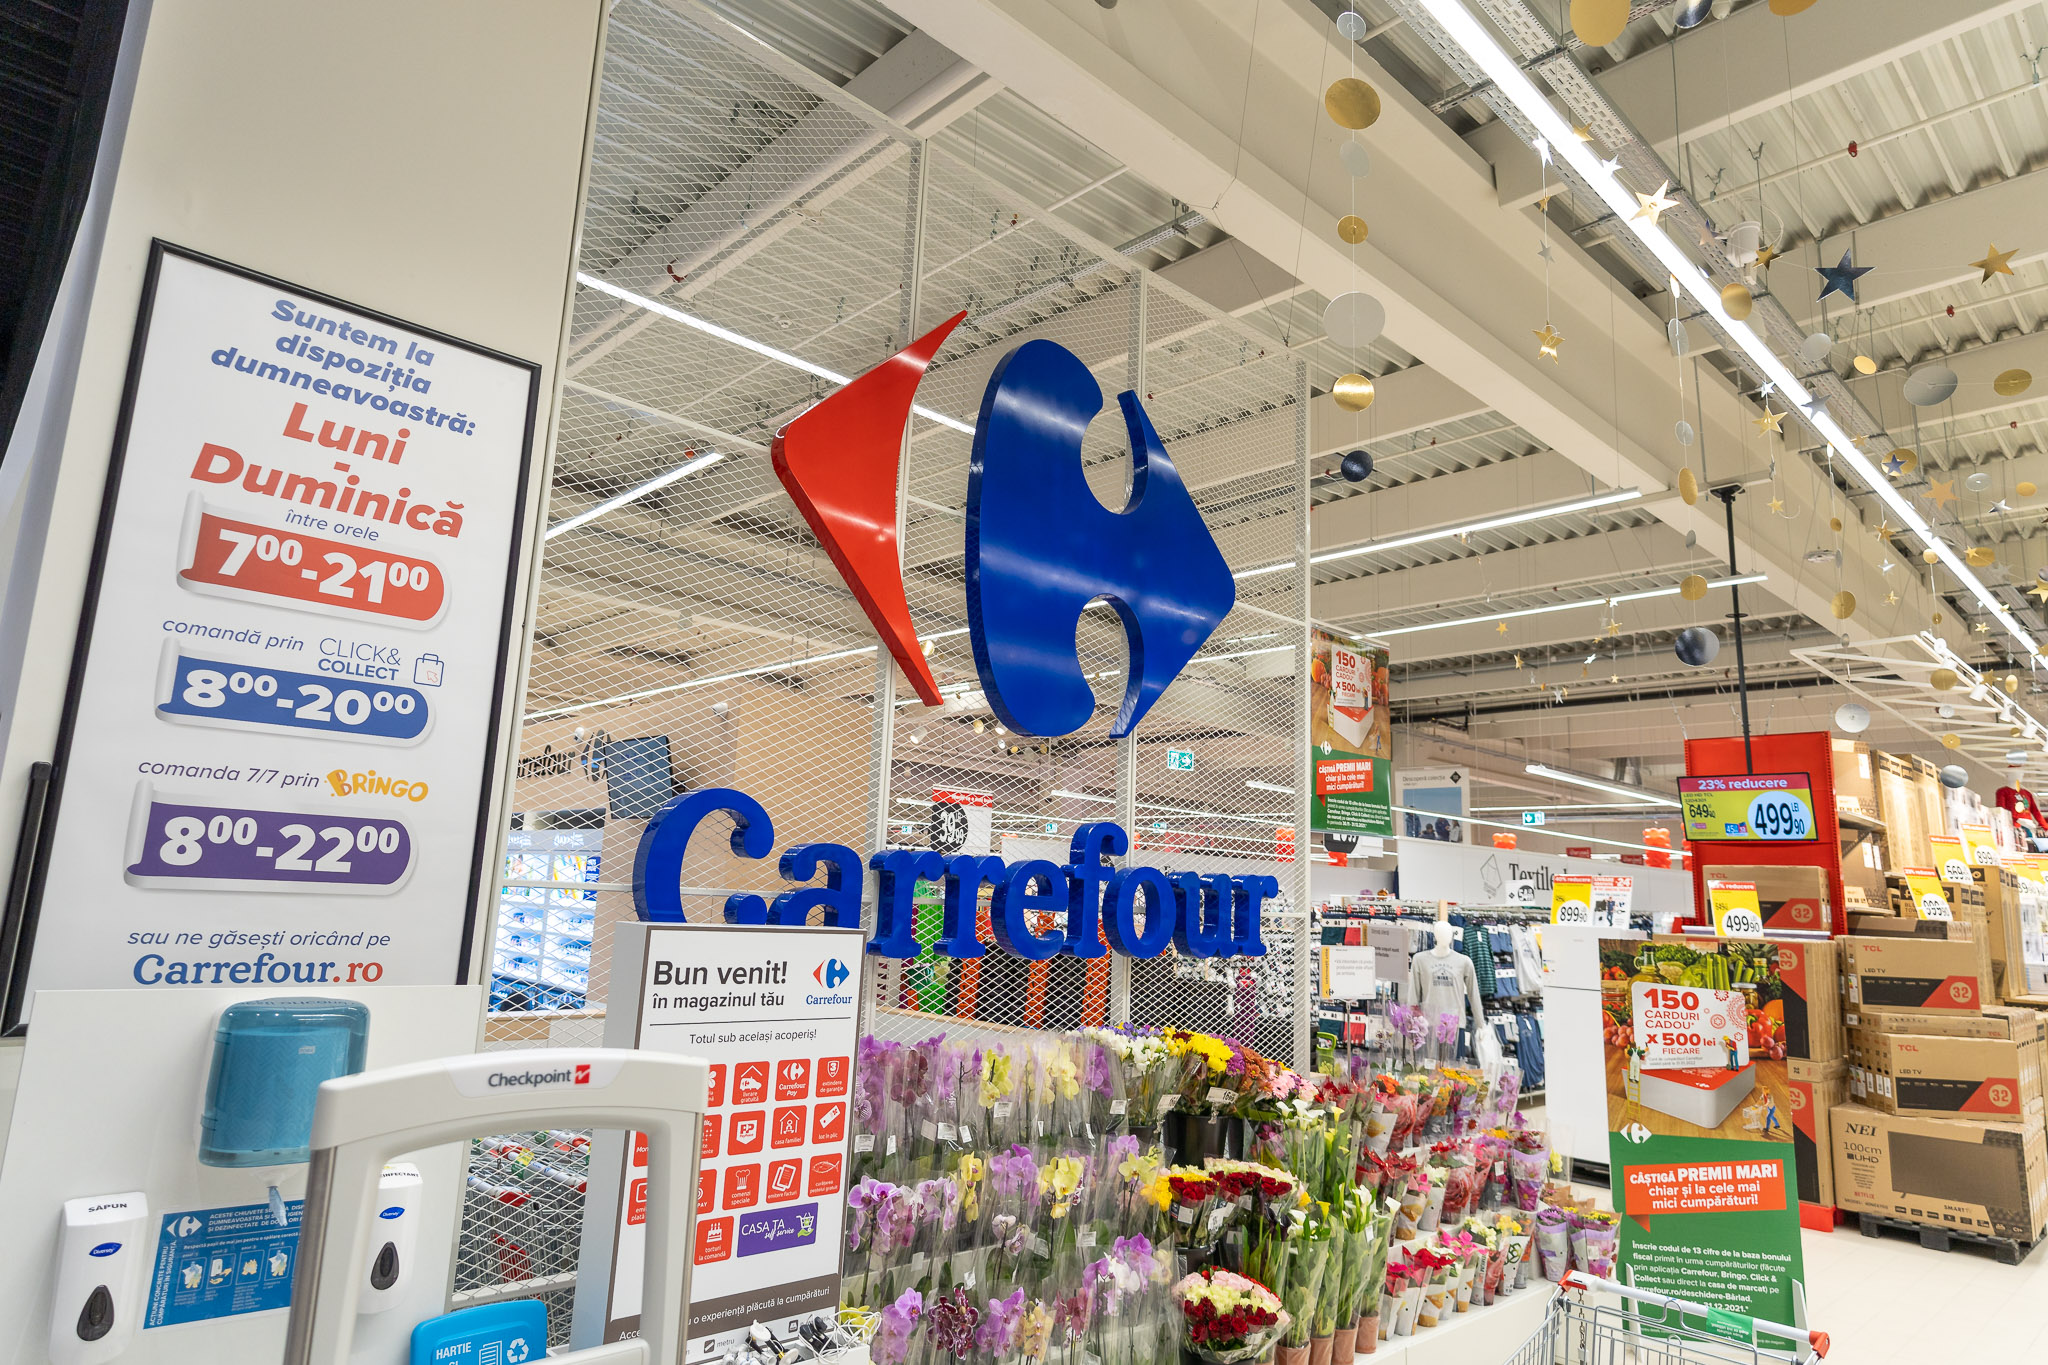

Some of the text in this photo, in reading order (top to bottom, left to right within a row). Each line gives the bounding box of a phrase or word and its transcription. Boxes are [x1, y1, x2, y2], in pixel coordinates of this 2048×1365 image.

[271, 300, 434, 367] Suntem la
[276, 334, 432, 394] dispoziția
[211, 347, 476, 436] dumneavoastră:
[283, 401, 411, 465] Luni
[190, 442, 464, 538] Duminică
[285, 509, 379, 542] între orele
[162, 619, 305, 652] comandă prin
[319, 637, 401, 666] CLICK&
[1336, 650, 1356, 669] 150
[318, 658, 399, 681] COLLECT
[1341, 682, 1356, 693] 500
[138, 760, 320, 789] comanda 7/7 prin
[1336, 761, 1371, 772] PREMII MARI
[1698, 778, 1788, 790] 23% reducere
[1689, 803, 1709, 818] 649
[1755, 803, 1793, 835] 499
[1794, 819, 1805, 835] 90
[632, 788, 1279, 960] Carrefour
[1559, 906, 1579, 922] 899
[1794, 908, 1810, 919] 32
[1727, 915, 1759, 932] 499 90
[127, 929, 391, 951] sau ne găsești oricând pe
[1780, 952, 1793, 967] 32
[132, 952, 384, 987] Carrefour.ro
[653, 960, 788, 986] Bun venit!
[805, 994, 852, 1006] Carrefour
[1644, 988, 1699, 1011] 150
[1952, 986, 1969, 999] 32
[652, 992, 785, 1012] în magazinul tău
[1645, 1010, 1699, 1021] CARDURI
[690, 1029, 817, 1045] Totul sub același acoperiș!
[1662, 1033, 1701, 1046] 500
[1703, 1037, 1716, 1046] lei
[1662, 1047, 1700, 1055] FIECARE
[1898, 1044, 1919, 1052] TCL
[488, 1069, 571, 1088] Checkpoint
[778, 1082, 806, 1091] Carrefour
[786, 1089, 798, 1098] Pay
[1992, 1089, 2009, 1102] 32
[1845, 1122, 1878, 1137] NEI
[1843, 1142, 1882, 1155] 100cm
[1630, 1164, 1778, 1187] CÂȘTIGĂ PREMII MARI
[1649, 1181, 1760, 1198] chiar și la cele mai
[1854, 1191, 1875, 1199] NETFLIX
[88, 1203, 128, 1213] SAPUN
[1652, 1194, 1759, 1210] mici cumpărături!
[742, 1218, 785, 1236] CASA TA
[1632, 1240, 1791, 1262] Înscrie codul de 13 cifre de la baza bonului
[1633, 1252, 1653, 1261] fiscal
[1654, 1254, 1675, 1263] primit
[1705, 1257, 1758, 1270] cumpărăturilor
[1633, 1263, 1648, 1272] prin
[1750, 1272, 1769, 1281] Click
[1634, 1274, 1779, 1294] Collect sau direct la casa de marcat) pe
[702, 1305, 745, 1322] experiență
[746, 1298, 775, 1313] plăcută
[777, 1295, 784, 1305] la
[785, 1286, 830, 1304] cumpărături
[436, 1342, 472, 1360] HARTIE
